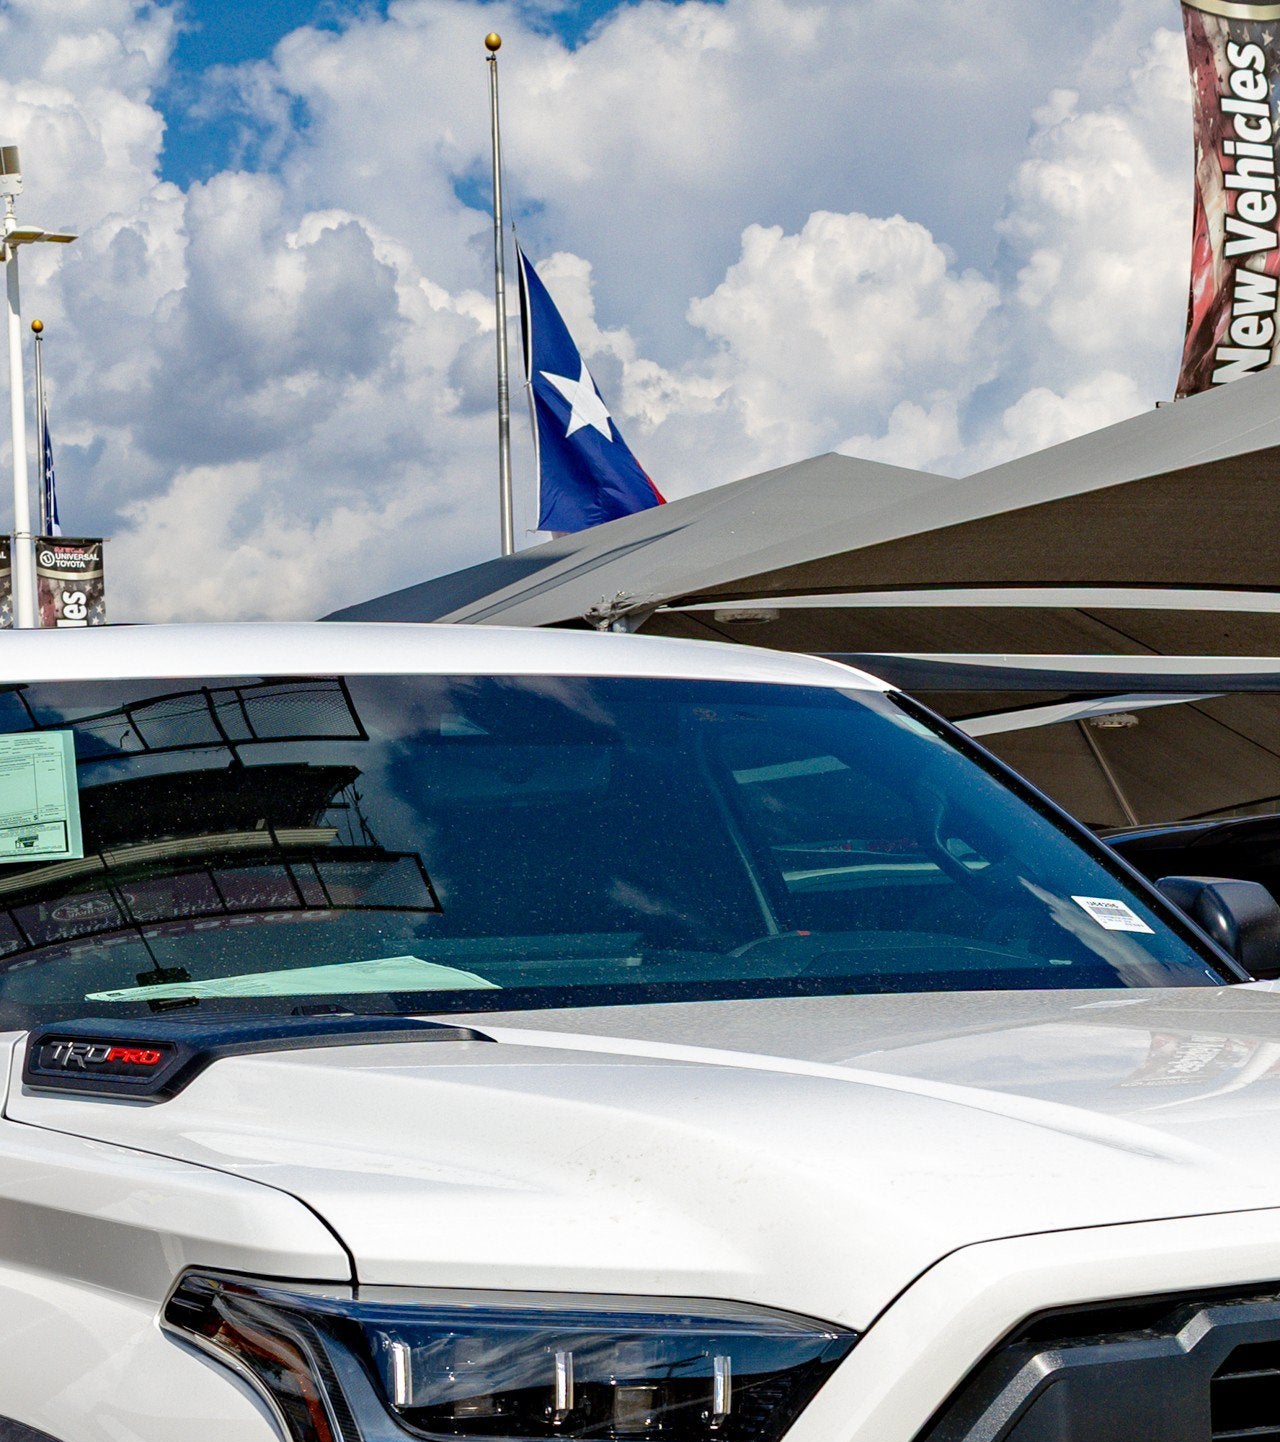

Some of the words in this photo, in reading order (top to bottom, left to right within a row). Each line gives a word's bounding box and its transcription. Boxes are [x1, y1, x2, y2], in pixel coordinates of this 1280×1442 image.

[1221, 40, 1279, 259] Vehicles
[55, 553, 100, 561] UNIVERSAL
[55, 560, 86, 568] TOYOTA
[50, 1041, 112, 1069] TRD
[106, 1046, 162, 1066] PRO
